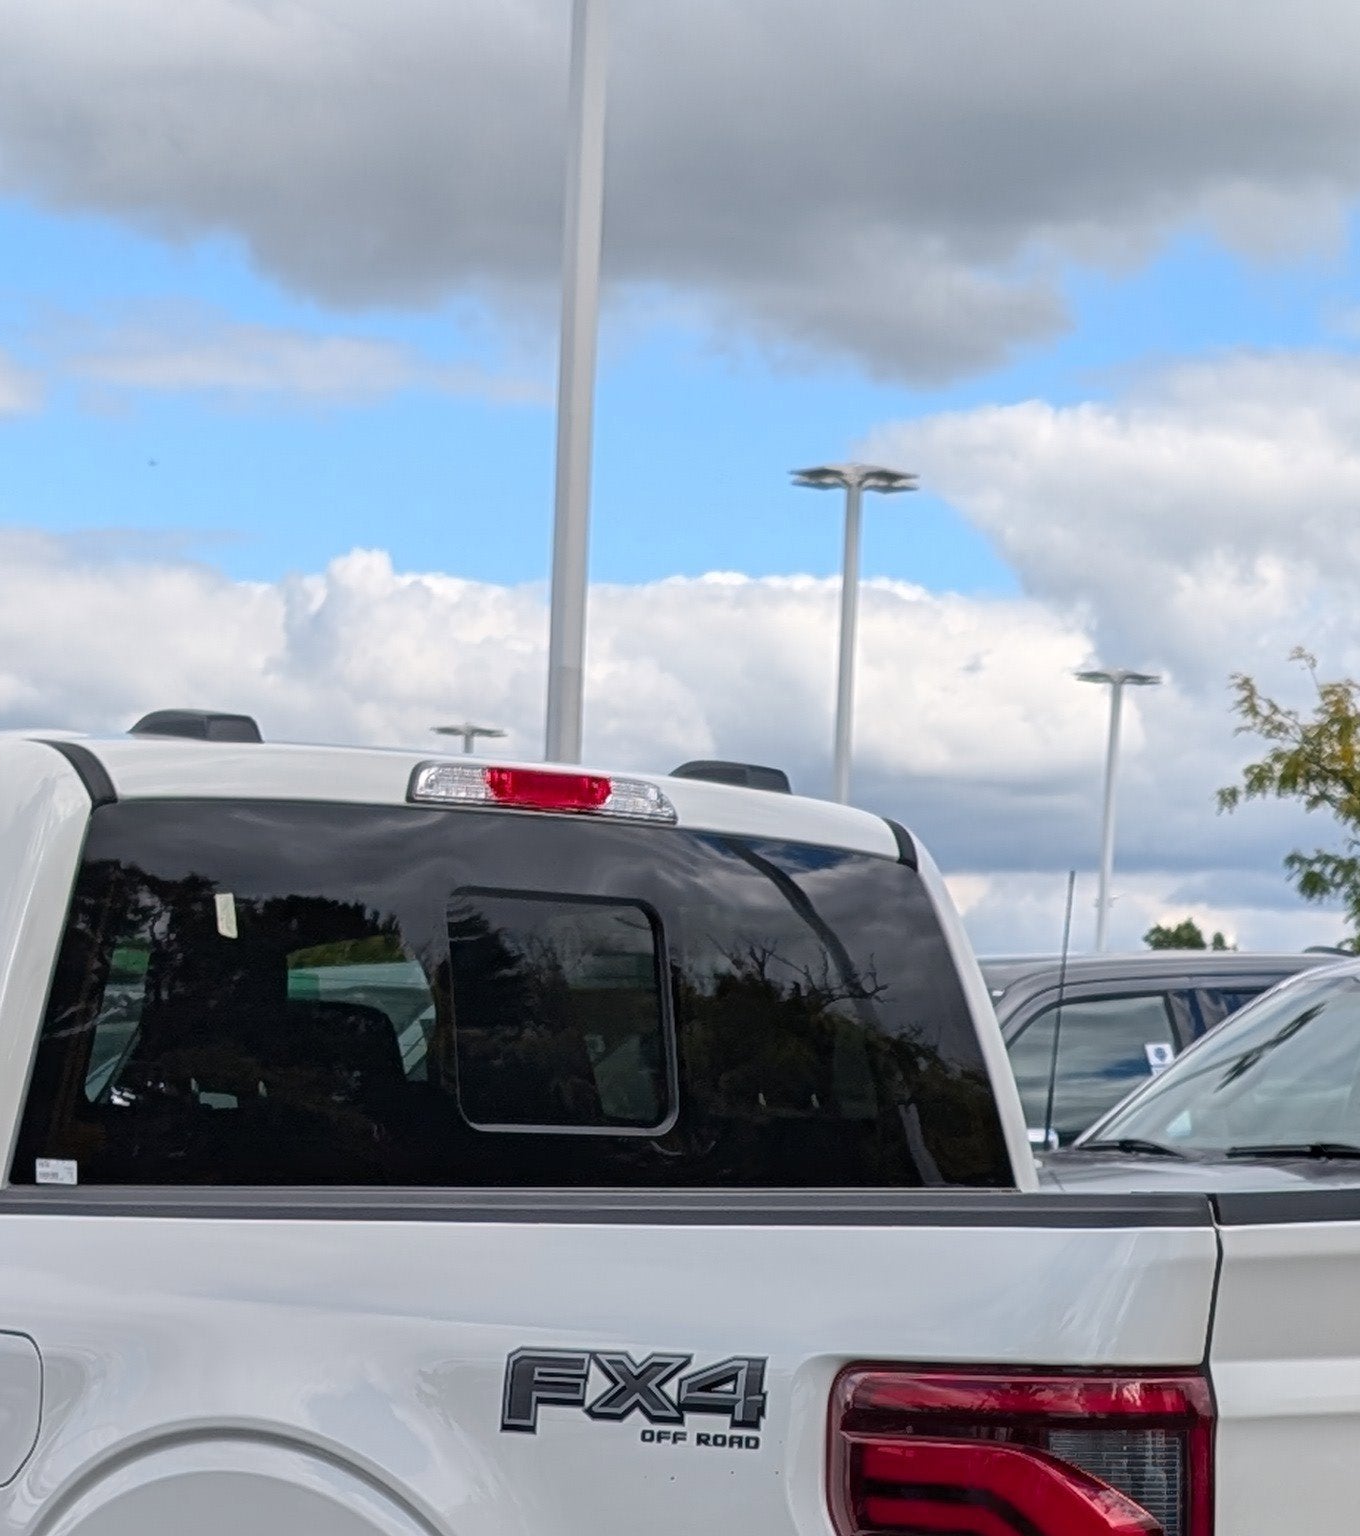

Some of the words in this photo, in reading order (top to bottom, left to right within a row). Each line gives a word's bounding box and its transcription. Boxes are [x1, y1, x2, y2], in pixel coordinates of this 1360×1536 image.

[499, 1345, 769, 1434] FX4
[640, 1429, 688, 1446] OFF
[696, 1432, 761, 1450] ROAD
